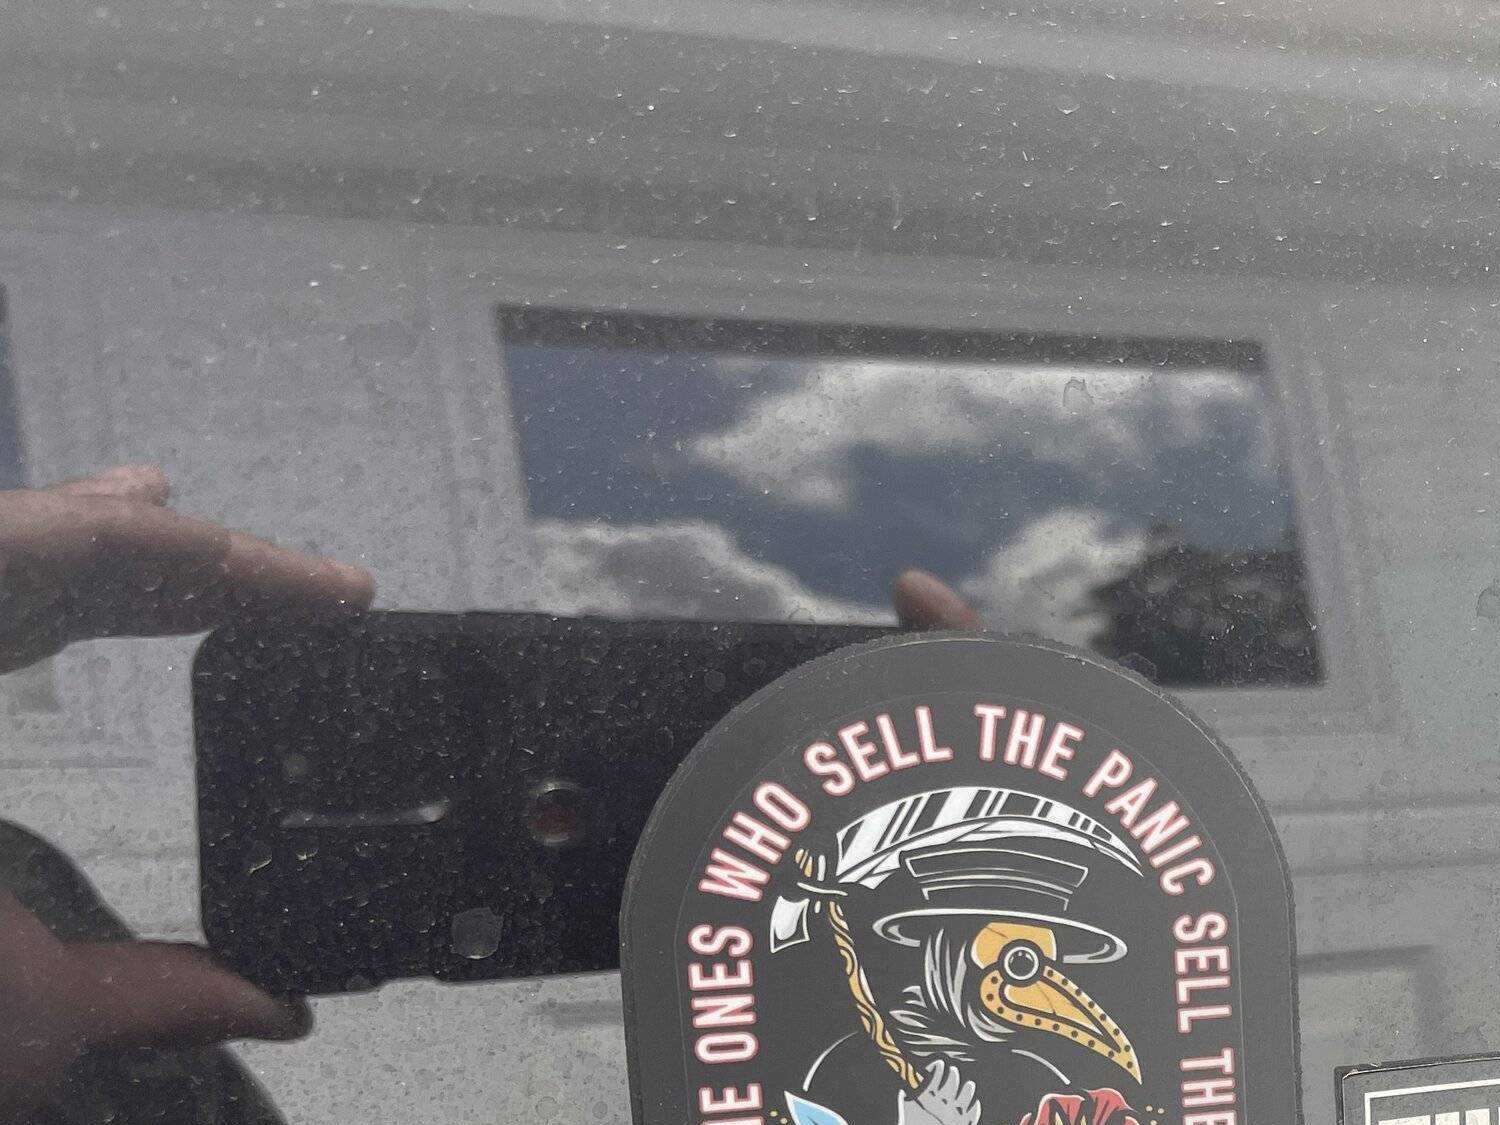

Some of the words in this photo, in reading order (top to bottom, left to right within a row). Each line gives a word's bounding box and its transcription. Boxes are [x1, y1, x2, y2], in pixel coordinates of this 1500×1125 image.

[803, 705, 953, 796] SELL
[973, 704, 1085, 781] THE
[700, 781, 811, 902] WHO
[1084, 750, 1216, 896] PANIC
[689, 924, 759, 1064] ONES
[1173, 911, 1234, 1034] SELL
